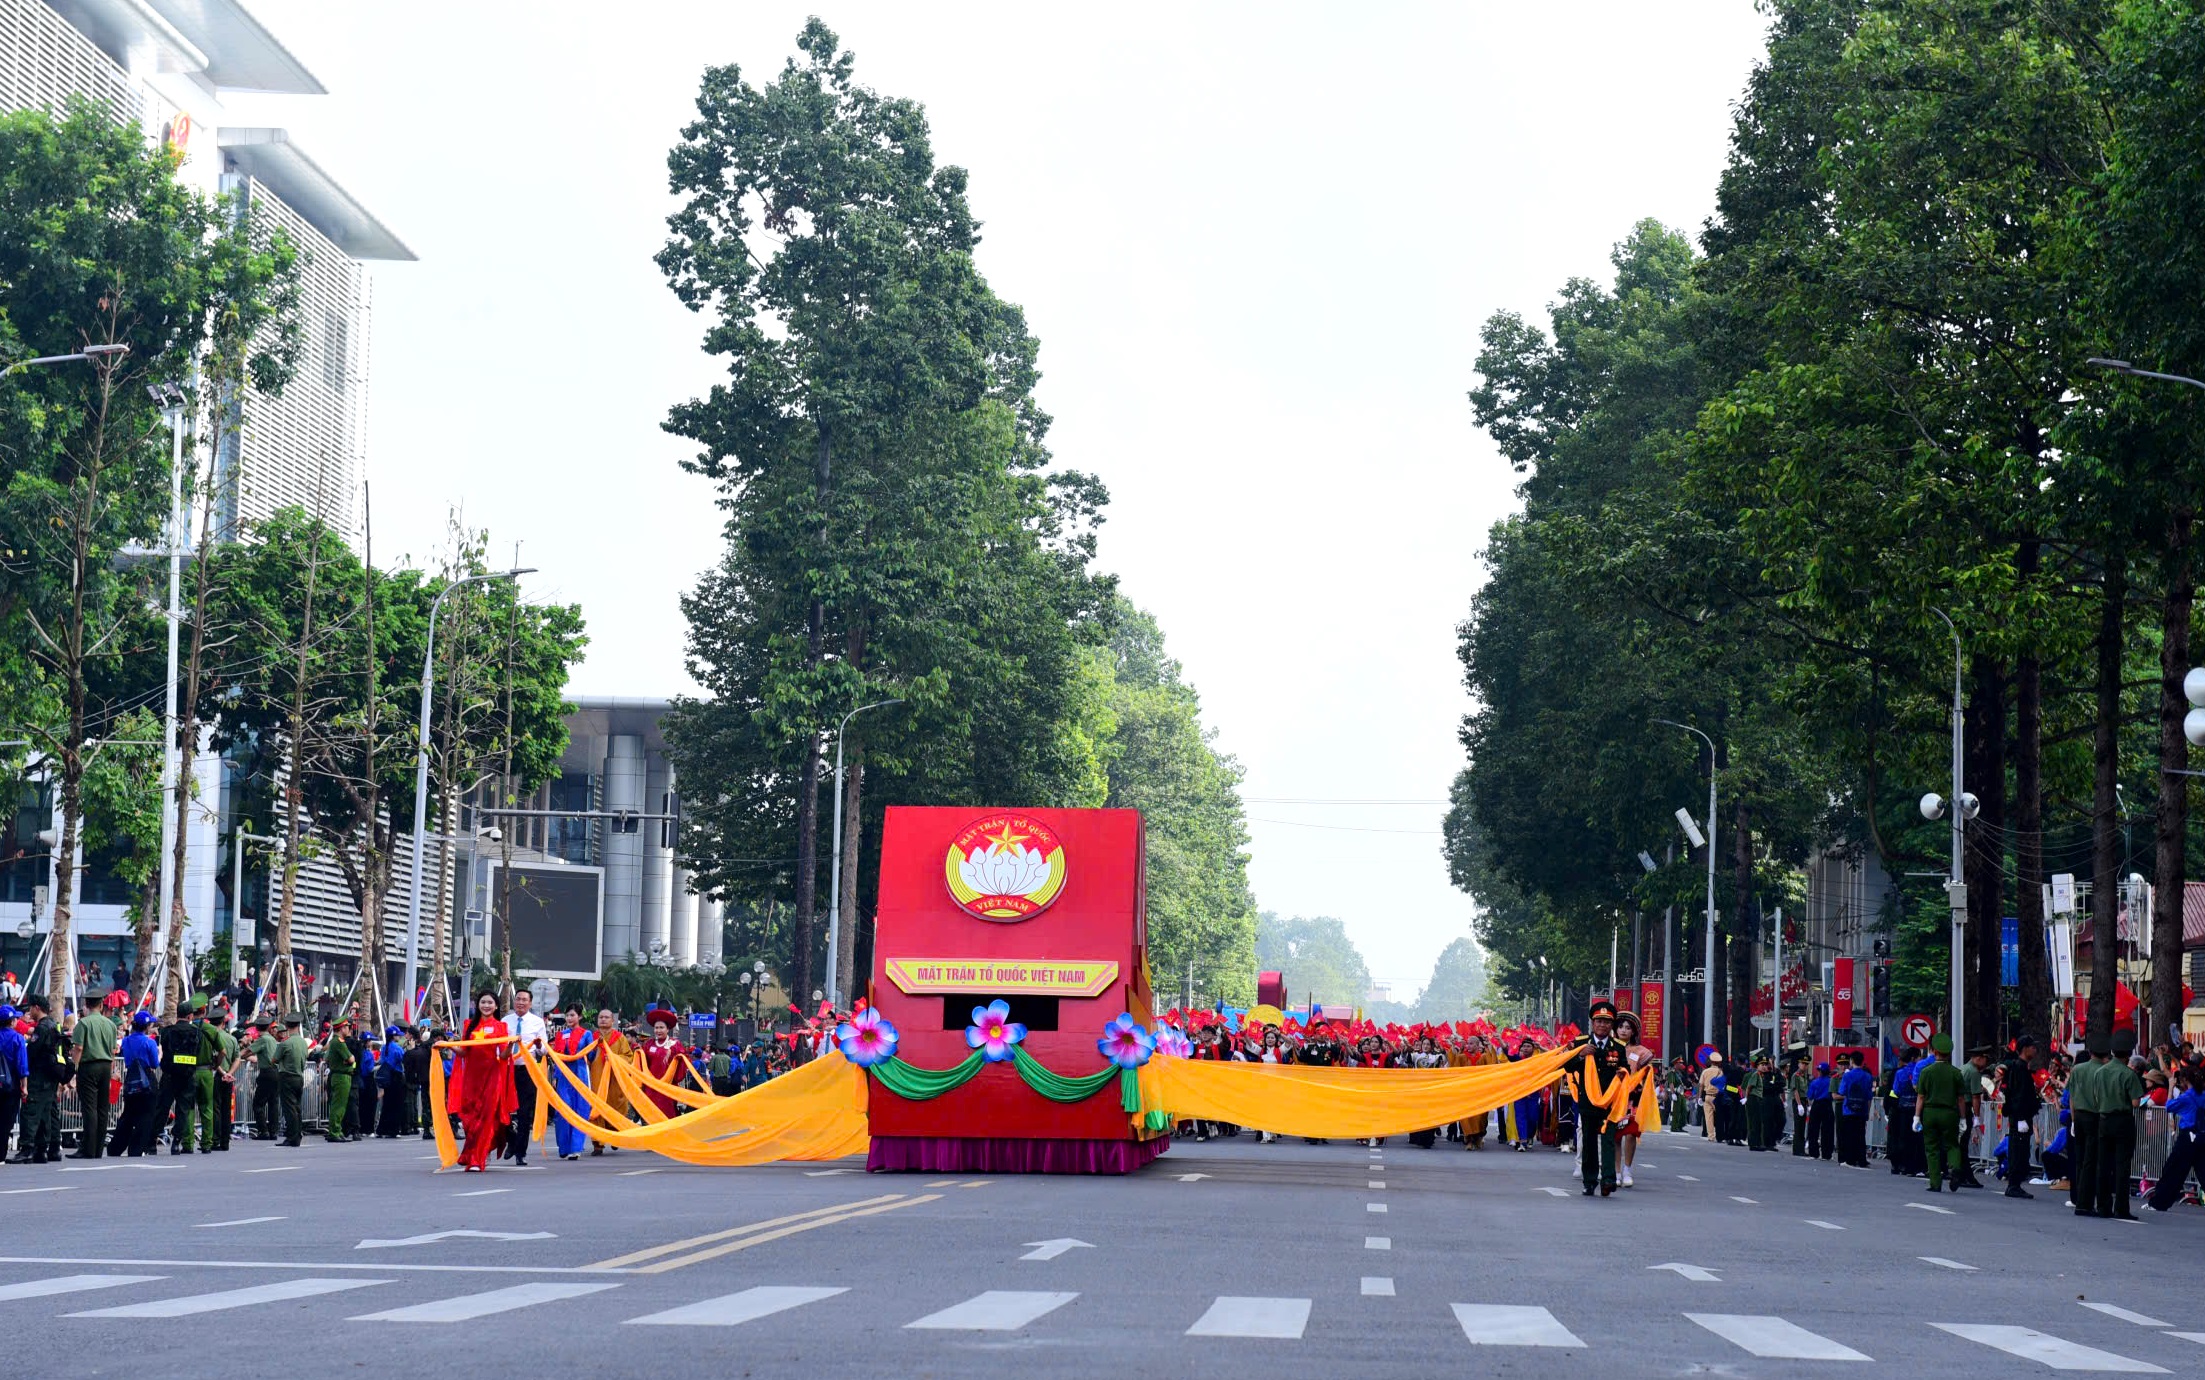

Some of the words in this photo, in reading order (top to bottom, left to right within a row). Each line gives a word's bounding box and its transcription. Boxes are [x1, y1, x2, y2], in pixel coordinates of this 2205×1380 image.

[960, 829, 977, 846] MẶT
[978, 818, 1005, 832] TRẬN
[1028, 825, 1051, 842] QUỐC
[976, 898, 1002, 910] VIỆT
[1005, 899, 1029, 911] NAM
[917, 966, 942, 984] MẶT
[946, 966, 976, 985] TRẬN
[979, 963, 995, 982] TỔ
[996, 964, 1027, 983] QUỐC
[1031, 966, 1055, 985] VIỆT
[1058, 969, 1086, 984] NAM
